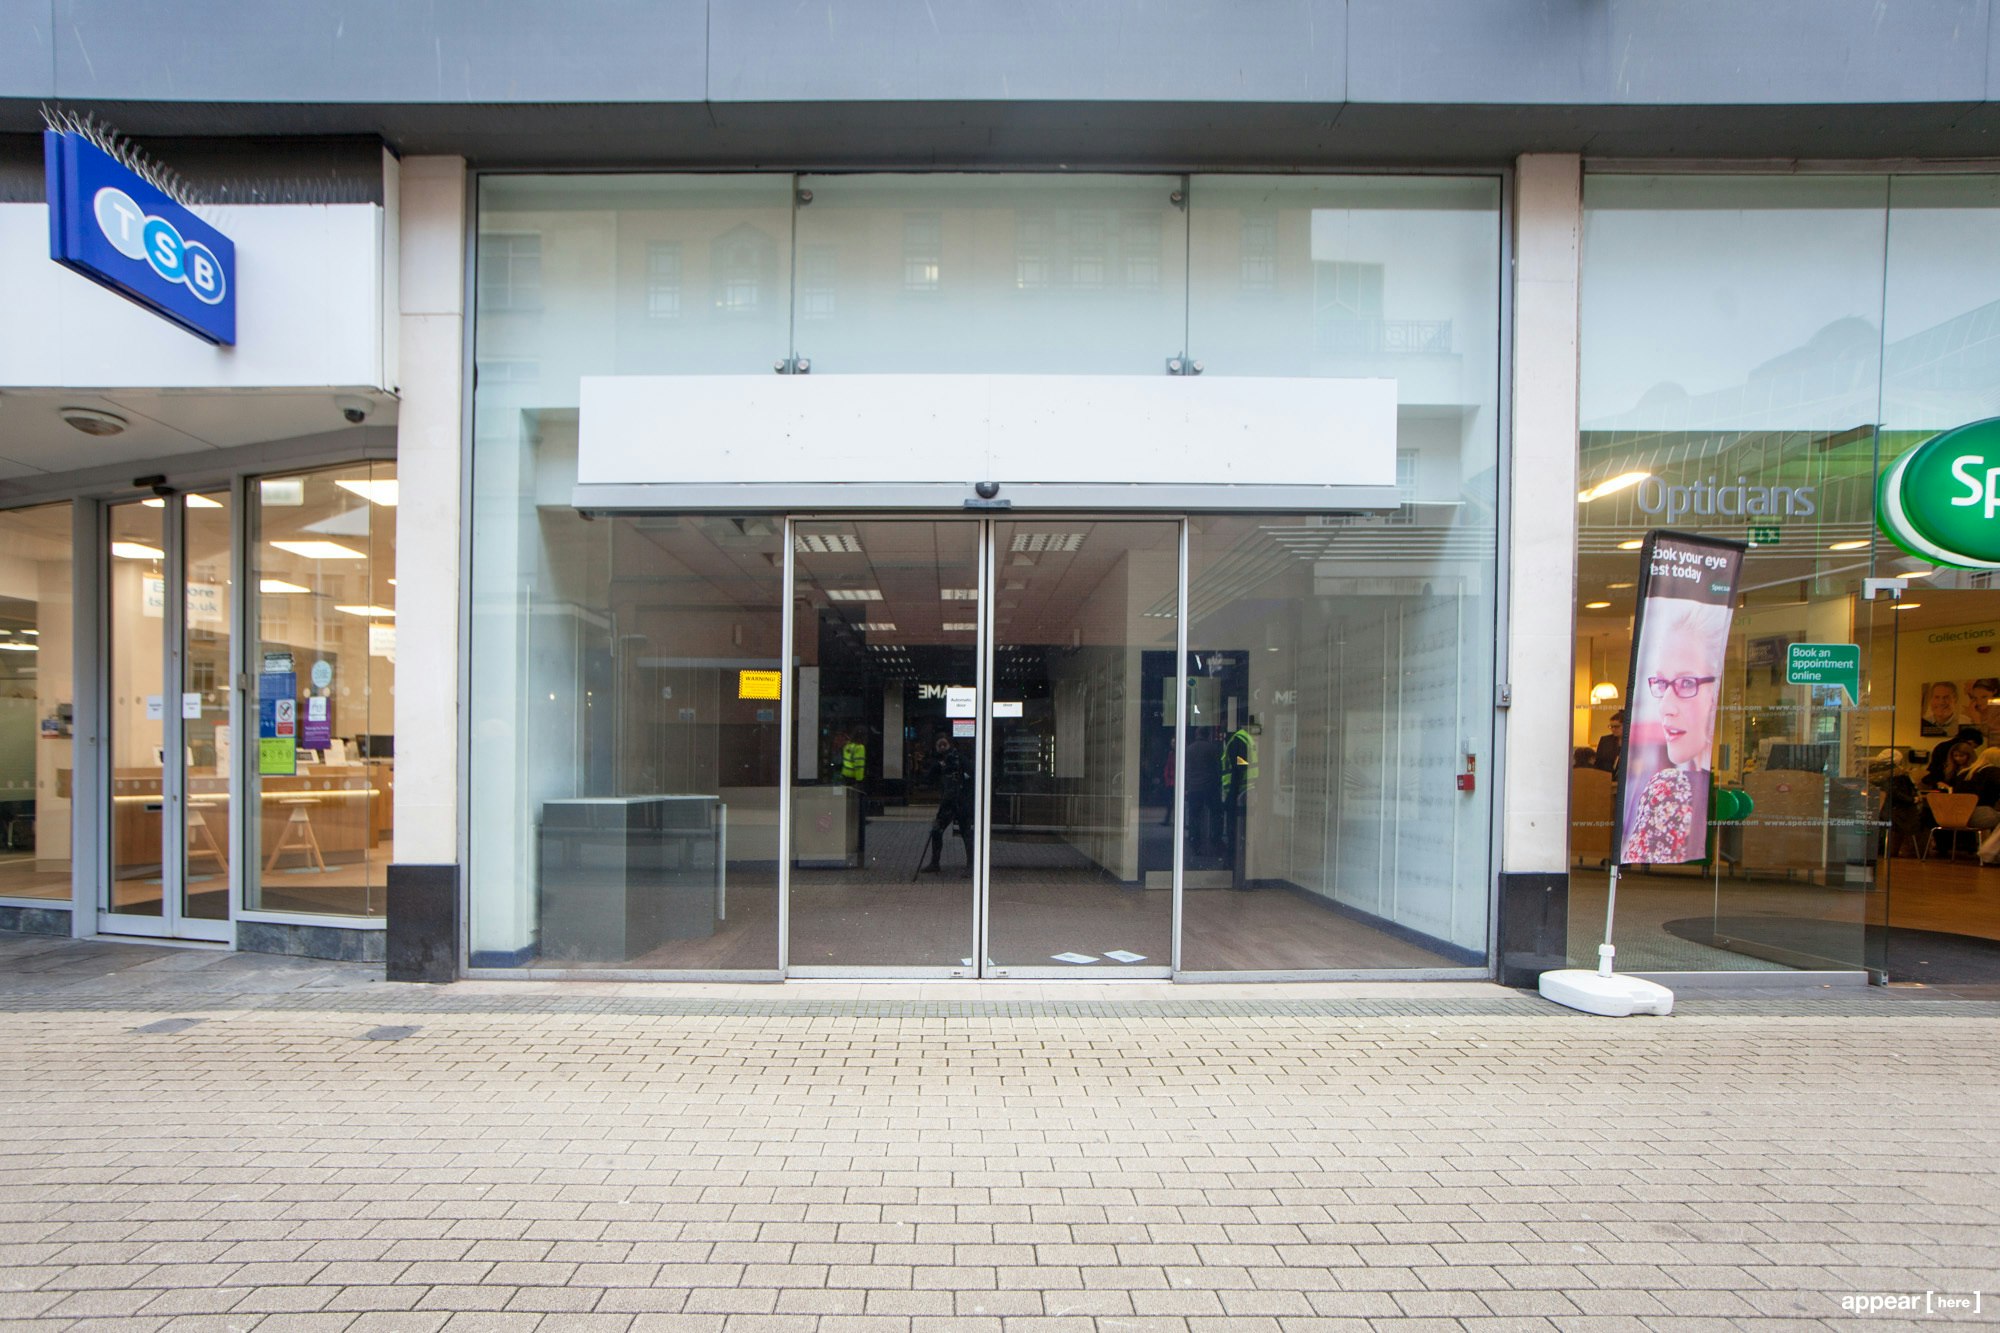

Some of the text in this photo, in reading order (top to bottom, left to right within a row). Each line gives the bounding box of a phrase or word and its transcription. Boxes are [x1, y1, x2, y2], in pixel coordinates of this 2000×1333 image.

[112, 202, 215, 292] TSB
[1637, 475, 1815, 524] Opticians
[1679, 551, 1703, 565] your
[1705, 555, 1727, 570] eye
[1672, 564, 1702, 583] today
[1928, 627, 1996, 644] Collections
[1792, 648, 1831, 657] Book an
[1792, 659, 1854, 669] appointment
[1791, 670, 1822, 681] online
